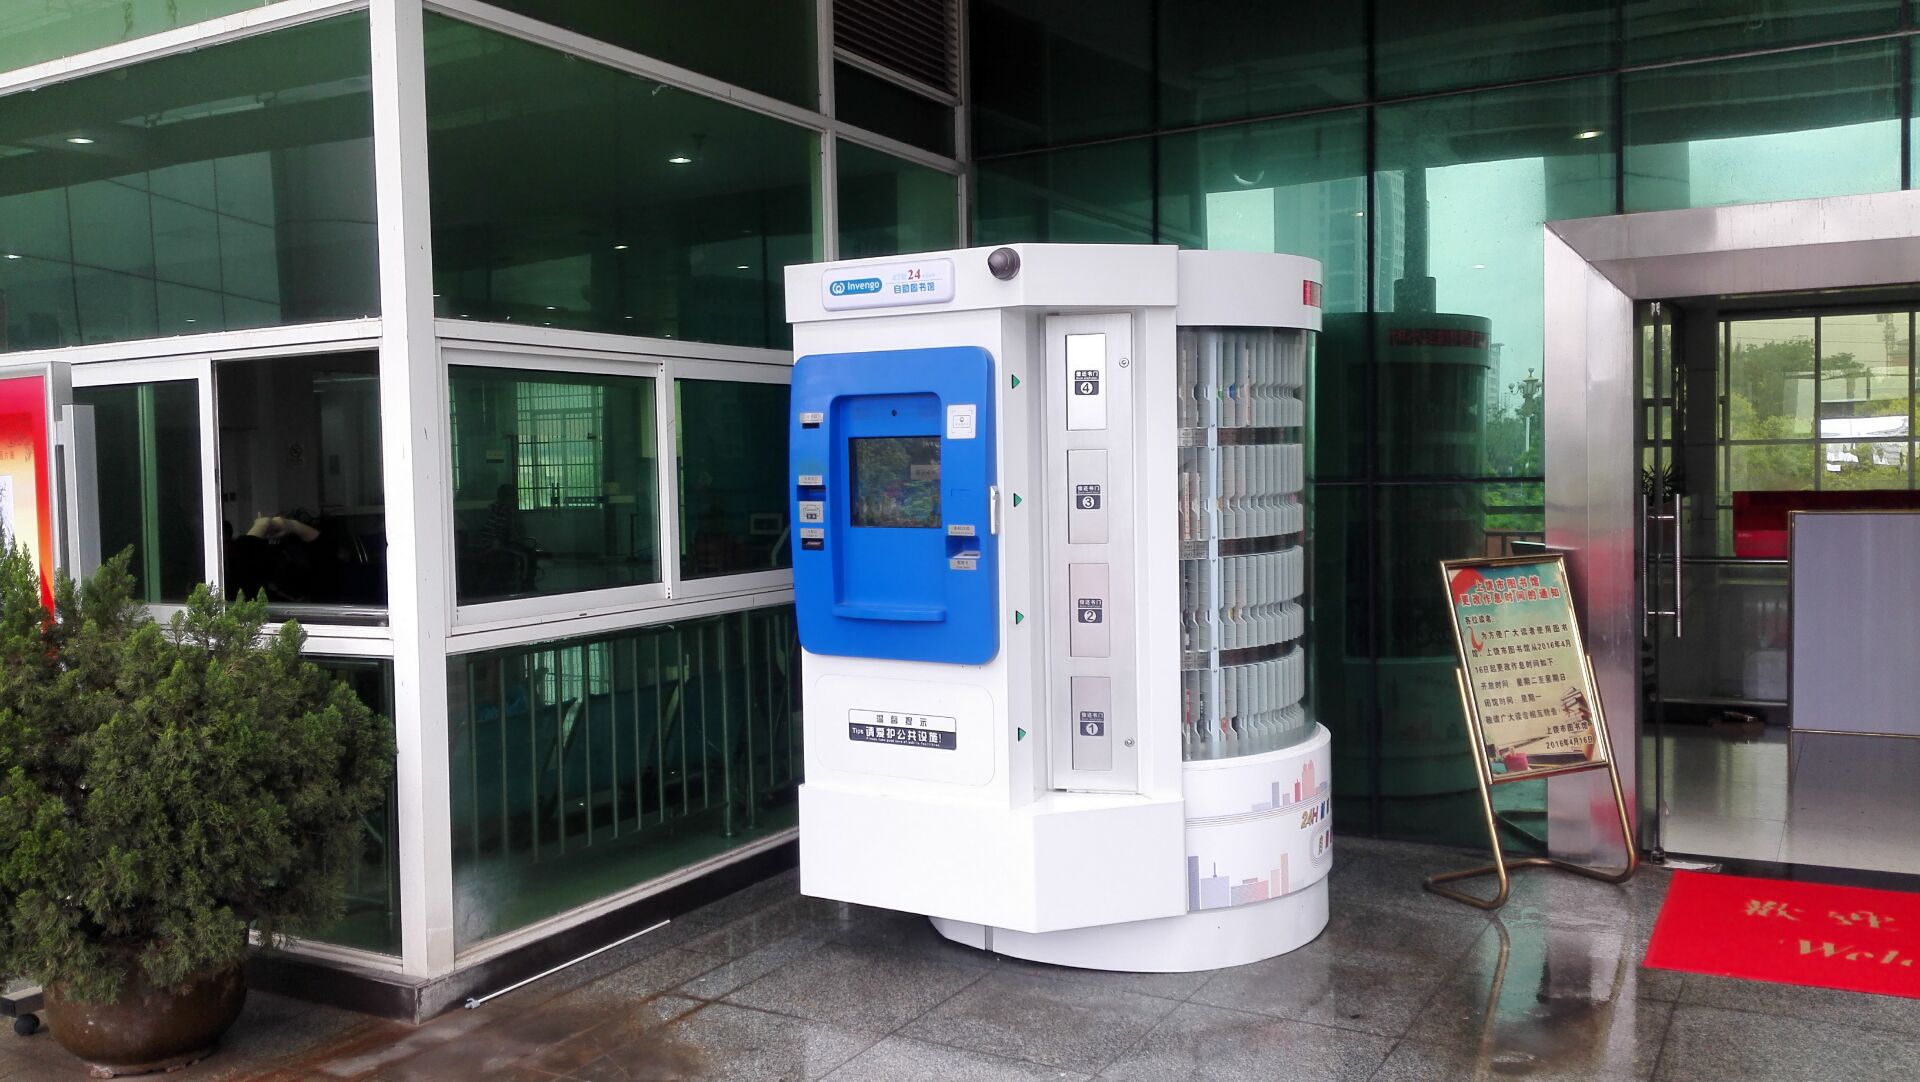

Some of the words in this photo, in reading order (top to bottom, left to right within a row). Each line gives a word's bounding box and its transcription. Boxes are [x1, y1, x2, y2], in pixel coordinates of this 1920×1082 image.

[907, 268, 921, 281] 24
[846, 280, 880, 292] Invengo
[893, 282, 935, 294] 自助图书馆
[1475, 575, 1540, 592] 上饶市图书馆
[1460, 588, 1561, 607] 更改作息时间的通知
[1481, 623, 1568, 640] 为方便广大读者使用图书
[876, 714, 927, 727] 温馨提示
[852, 727, 864, 735] Tips
[1546, 721, 1588, 735] 上饶市图书馆
[1545, 735, 1593, 750] 2016年4月16日
